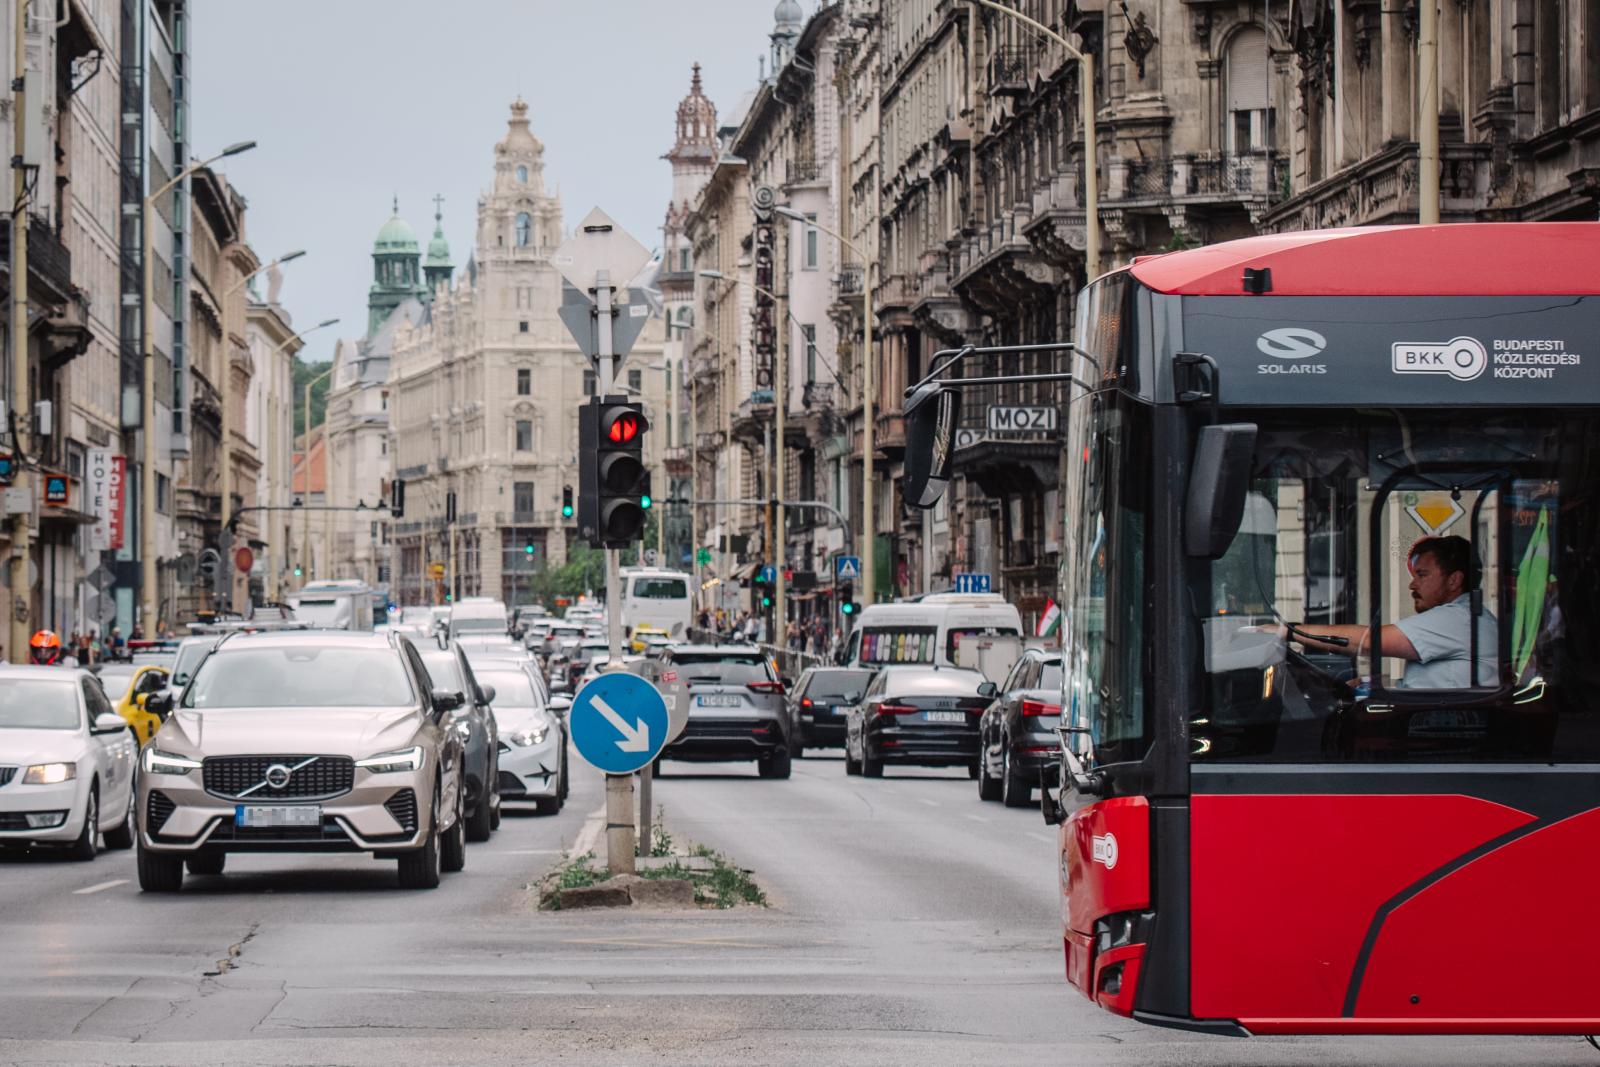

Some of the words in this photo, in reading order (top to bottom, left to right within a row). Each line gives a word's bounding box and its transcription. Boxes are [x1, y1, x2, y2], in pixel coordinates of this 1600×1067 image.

[1494, 340, 1564, 351] BUDAPESTI
[1406, 352, 1444, 364] BKK
[1494, 352, 1580, 365] KÖZLEKEDÉSI
[1257, 364, 1328, 375] SOLARIS
[1494, 366, 1555, 379] KÖZPONT
[995, 409, 1052, 428] MOZI
[94, 454, 105, 519] HOTEL
